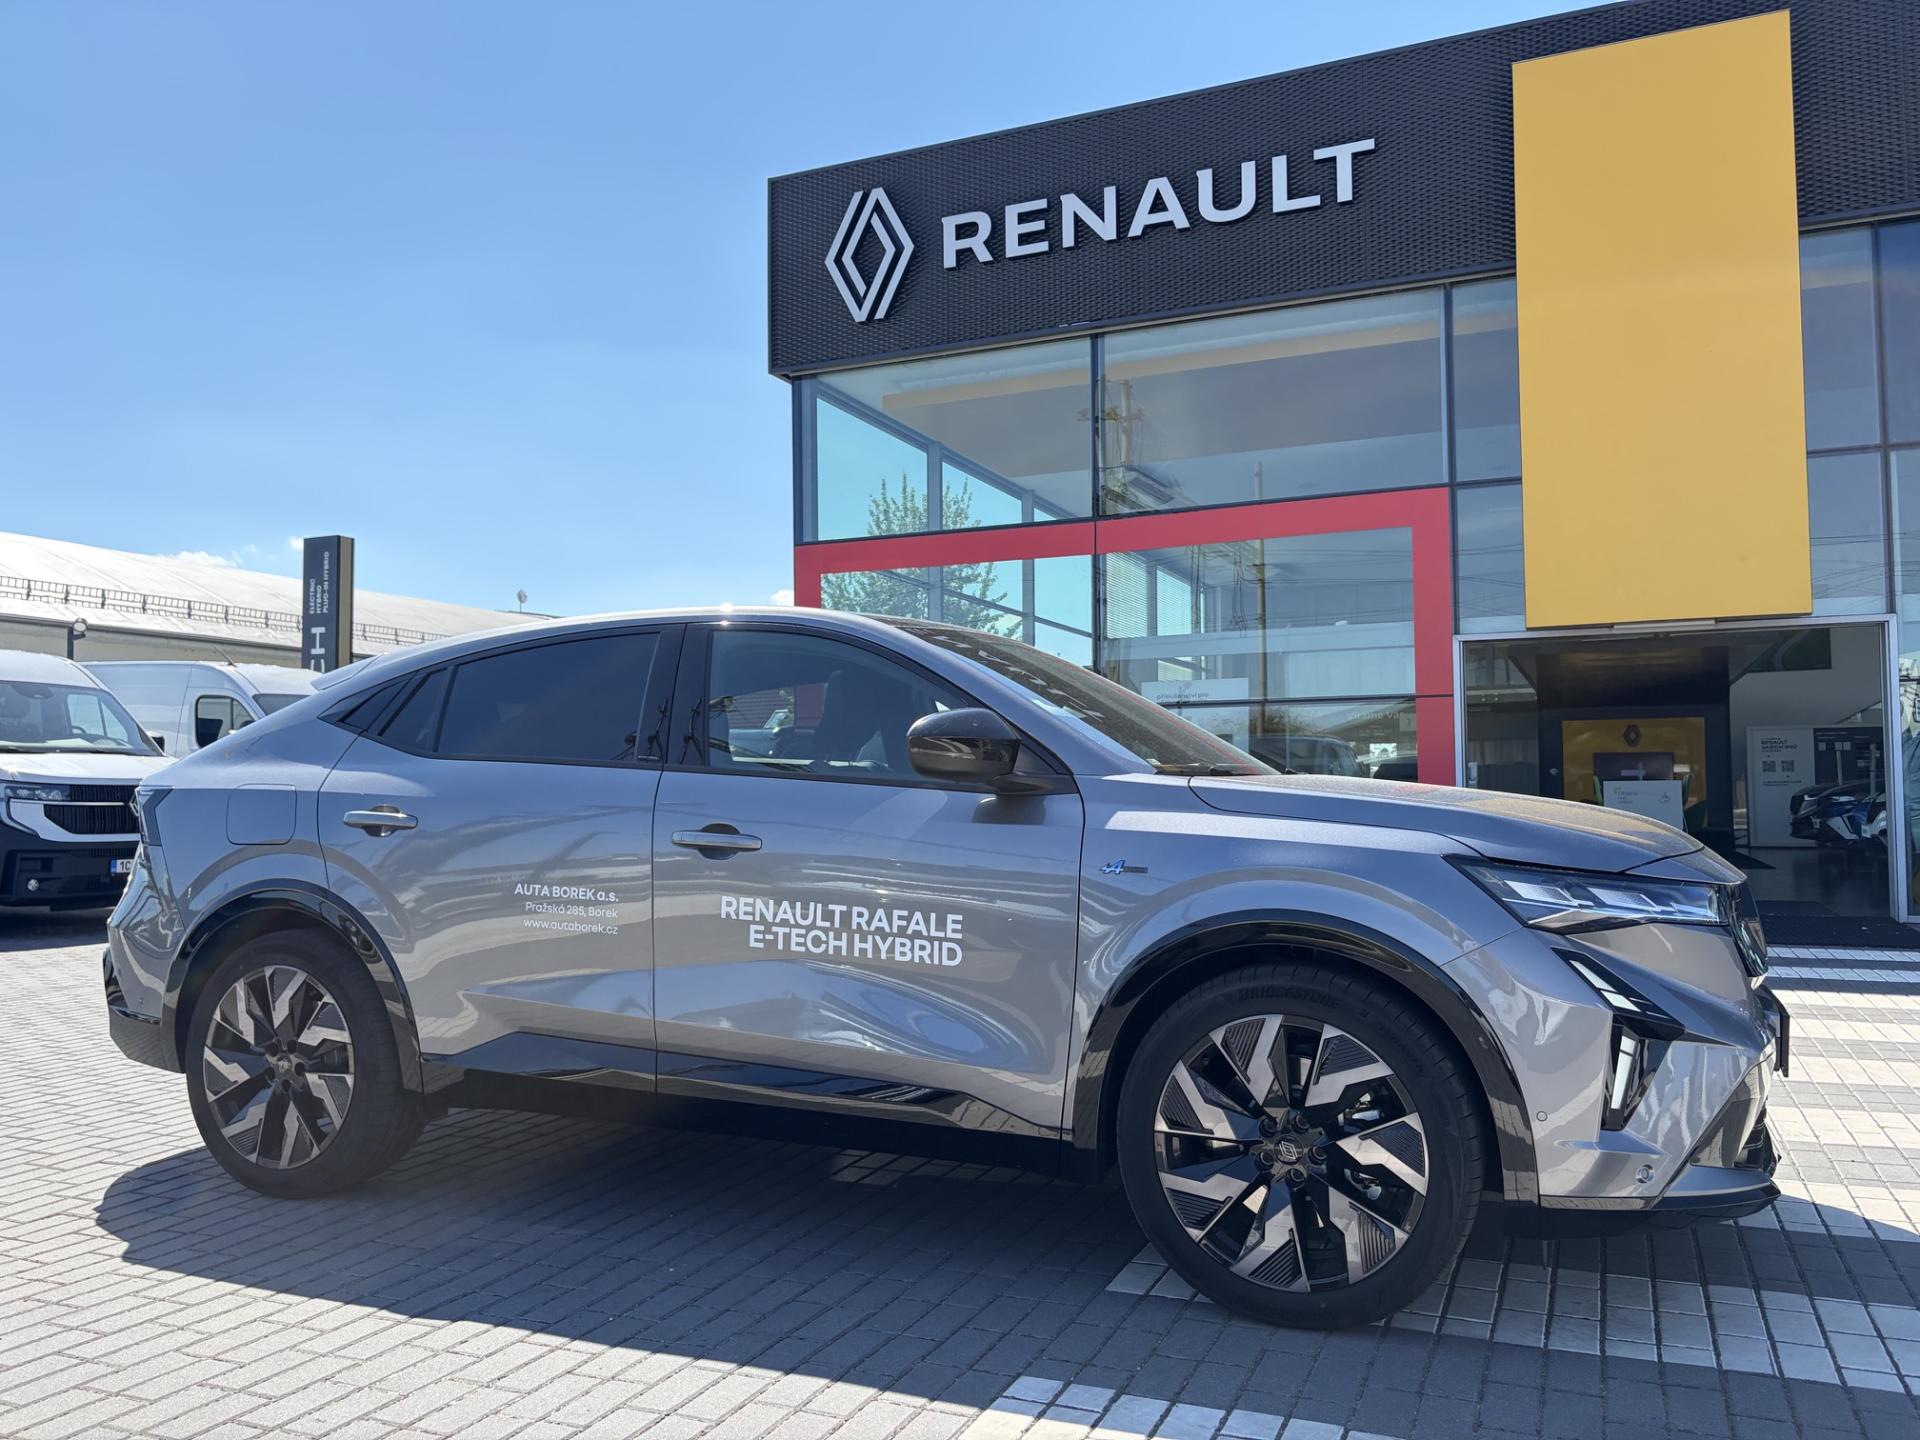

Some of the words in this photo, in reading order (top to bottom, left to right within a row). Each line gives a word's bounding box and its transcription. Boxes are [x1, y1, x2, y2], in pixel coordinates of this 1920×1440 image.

[942, 138, 1376, 269] RENAULT
[514, 883, 550, 897] AUTA
[552, 886, 596, 900] BOREK
[597, 890, 619, 902] a.s.
[525, 901, 565, 915] Pražská
[566, 905, 586, 918] 285,
[588, 906, 618, 919] Borek
[720, 895, 847, 928] RENAULT
[851, 906, 963, 939] RAFALE
[523, 919, 618, 935] www.autaborek.cz
[749, 924, 847, 956] E-TECH
[853, 933, 963, 967] HYBRID
